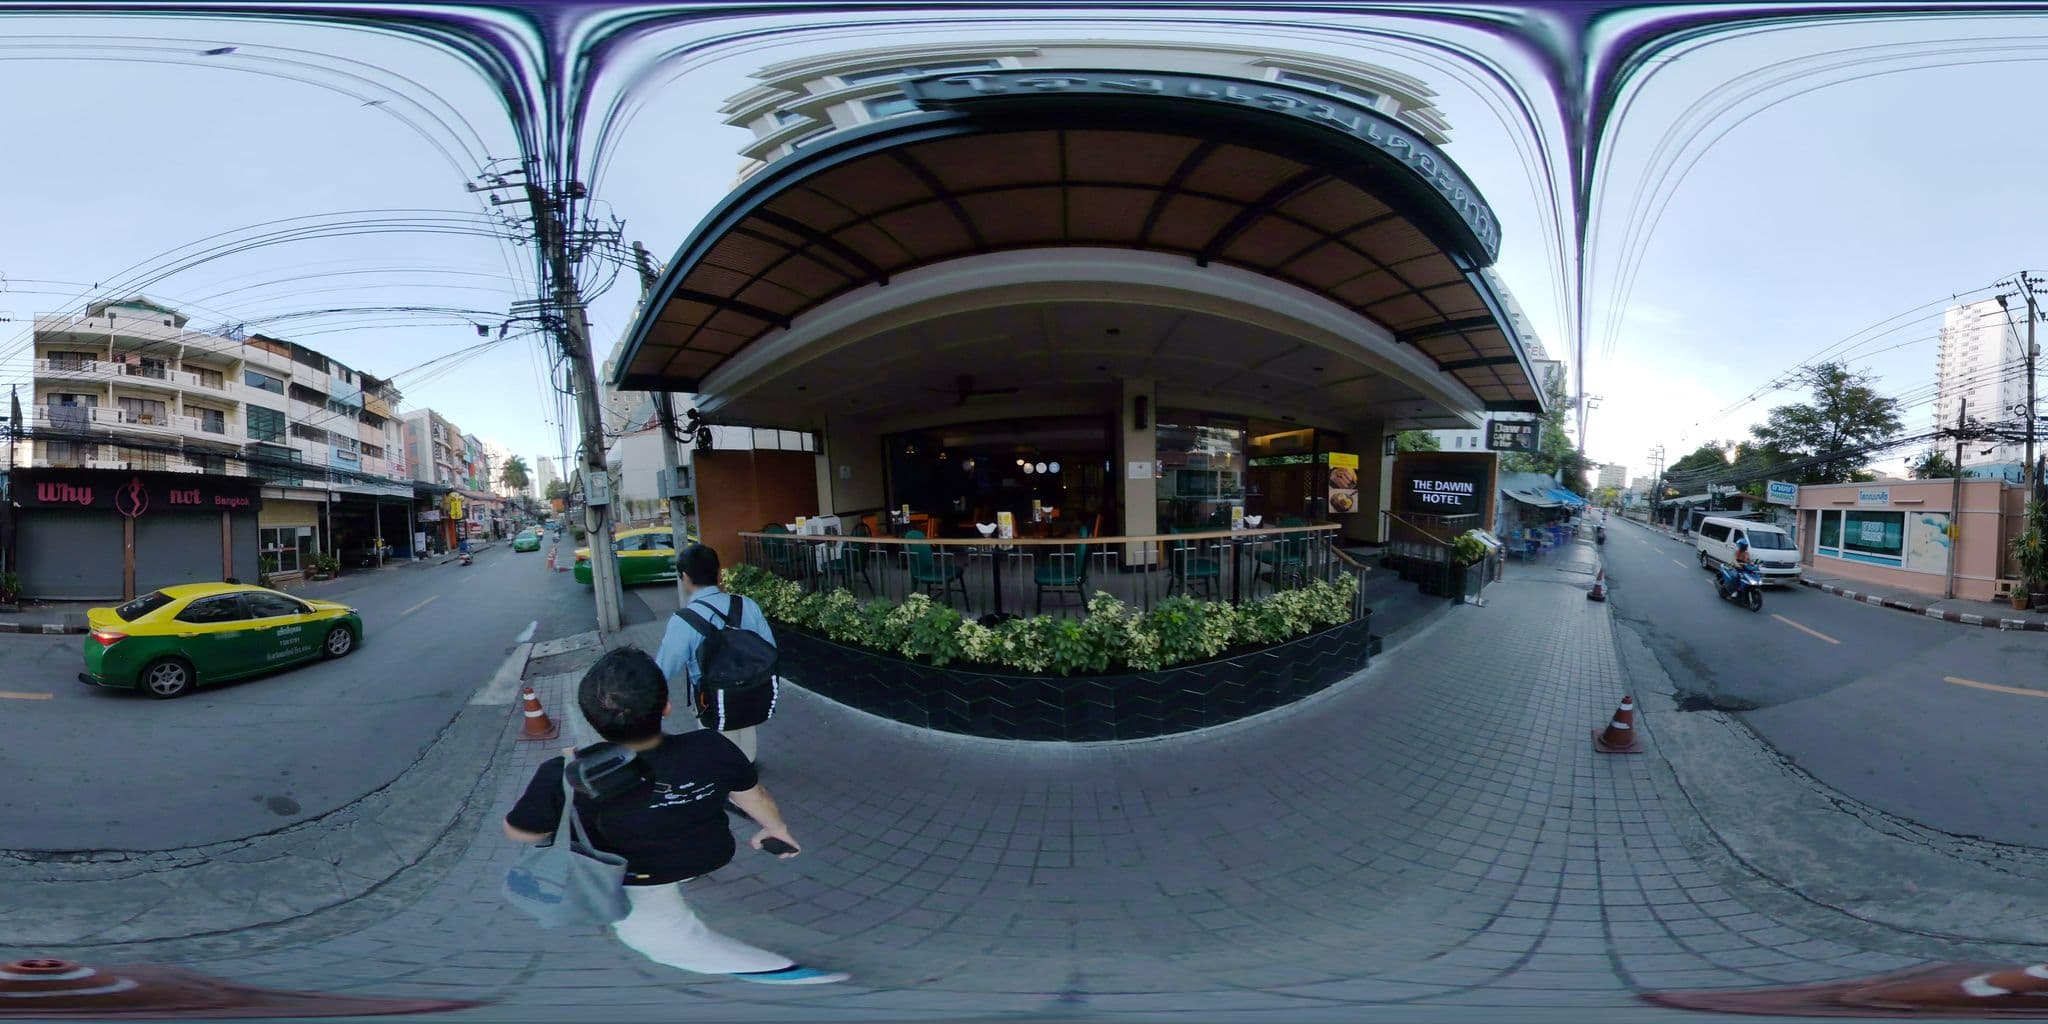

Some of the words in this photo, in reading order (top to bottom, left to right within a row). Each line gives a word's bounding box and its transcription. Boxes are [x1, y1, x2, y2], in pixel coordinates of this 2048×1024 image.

[1413, 479, 1432, 490] THE
[1434, 480, 1473, 493] DAWIN
[36, 482, 95, 506] Why
[170, 488, 202, 504] not
[214, 495, 249, 508] Bangkok
[1422, 493, 1462, 505] HOTEL
